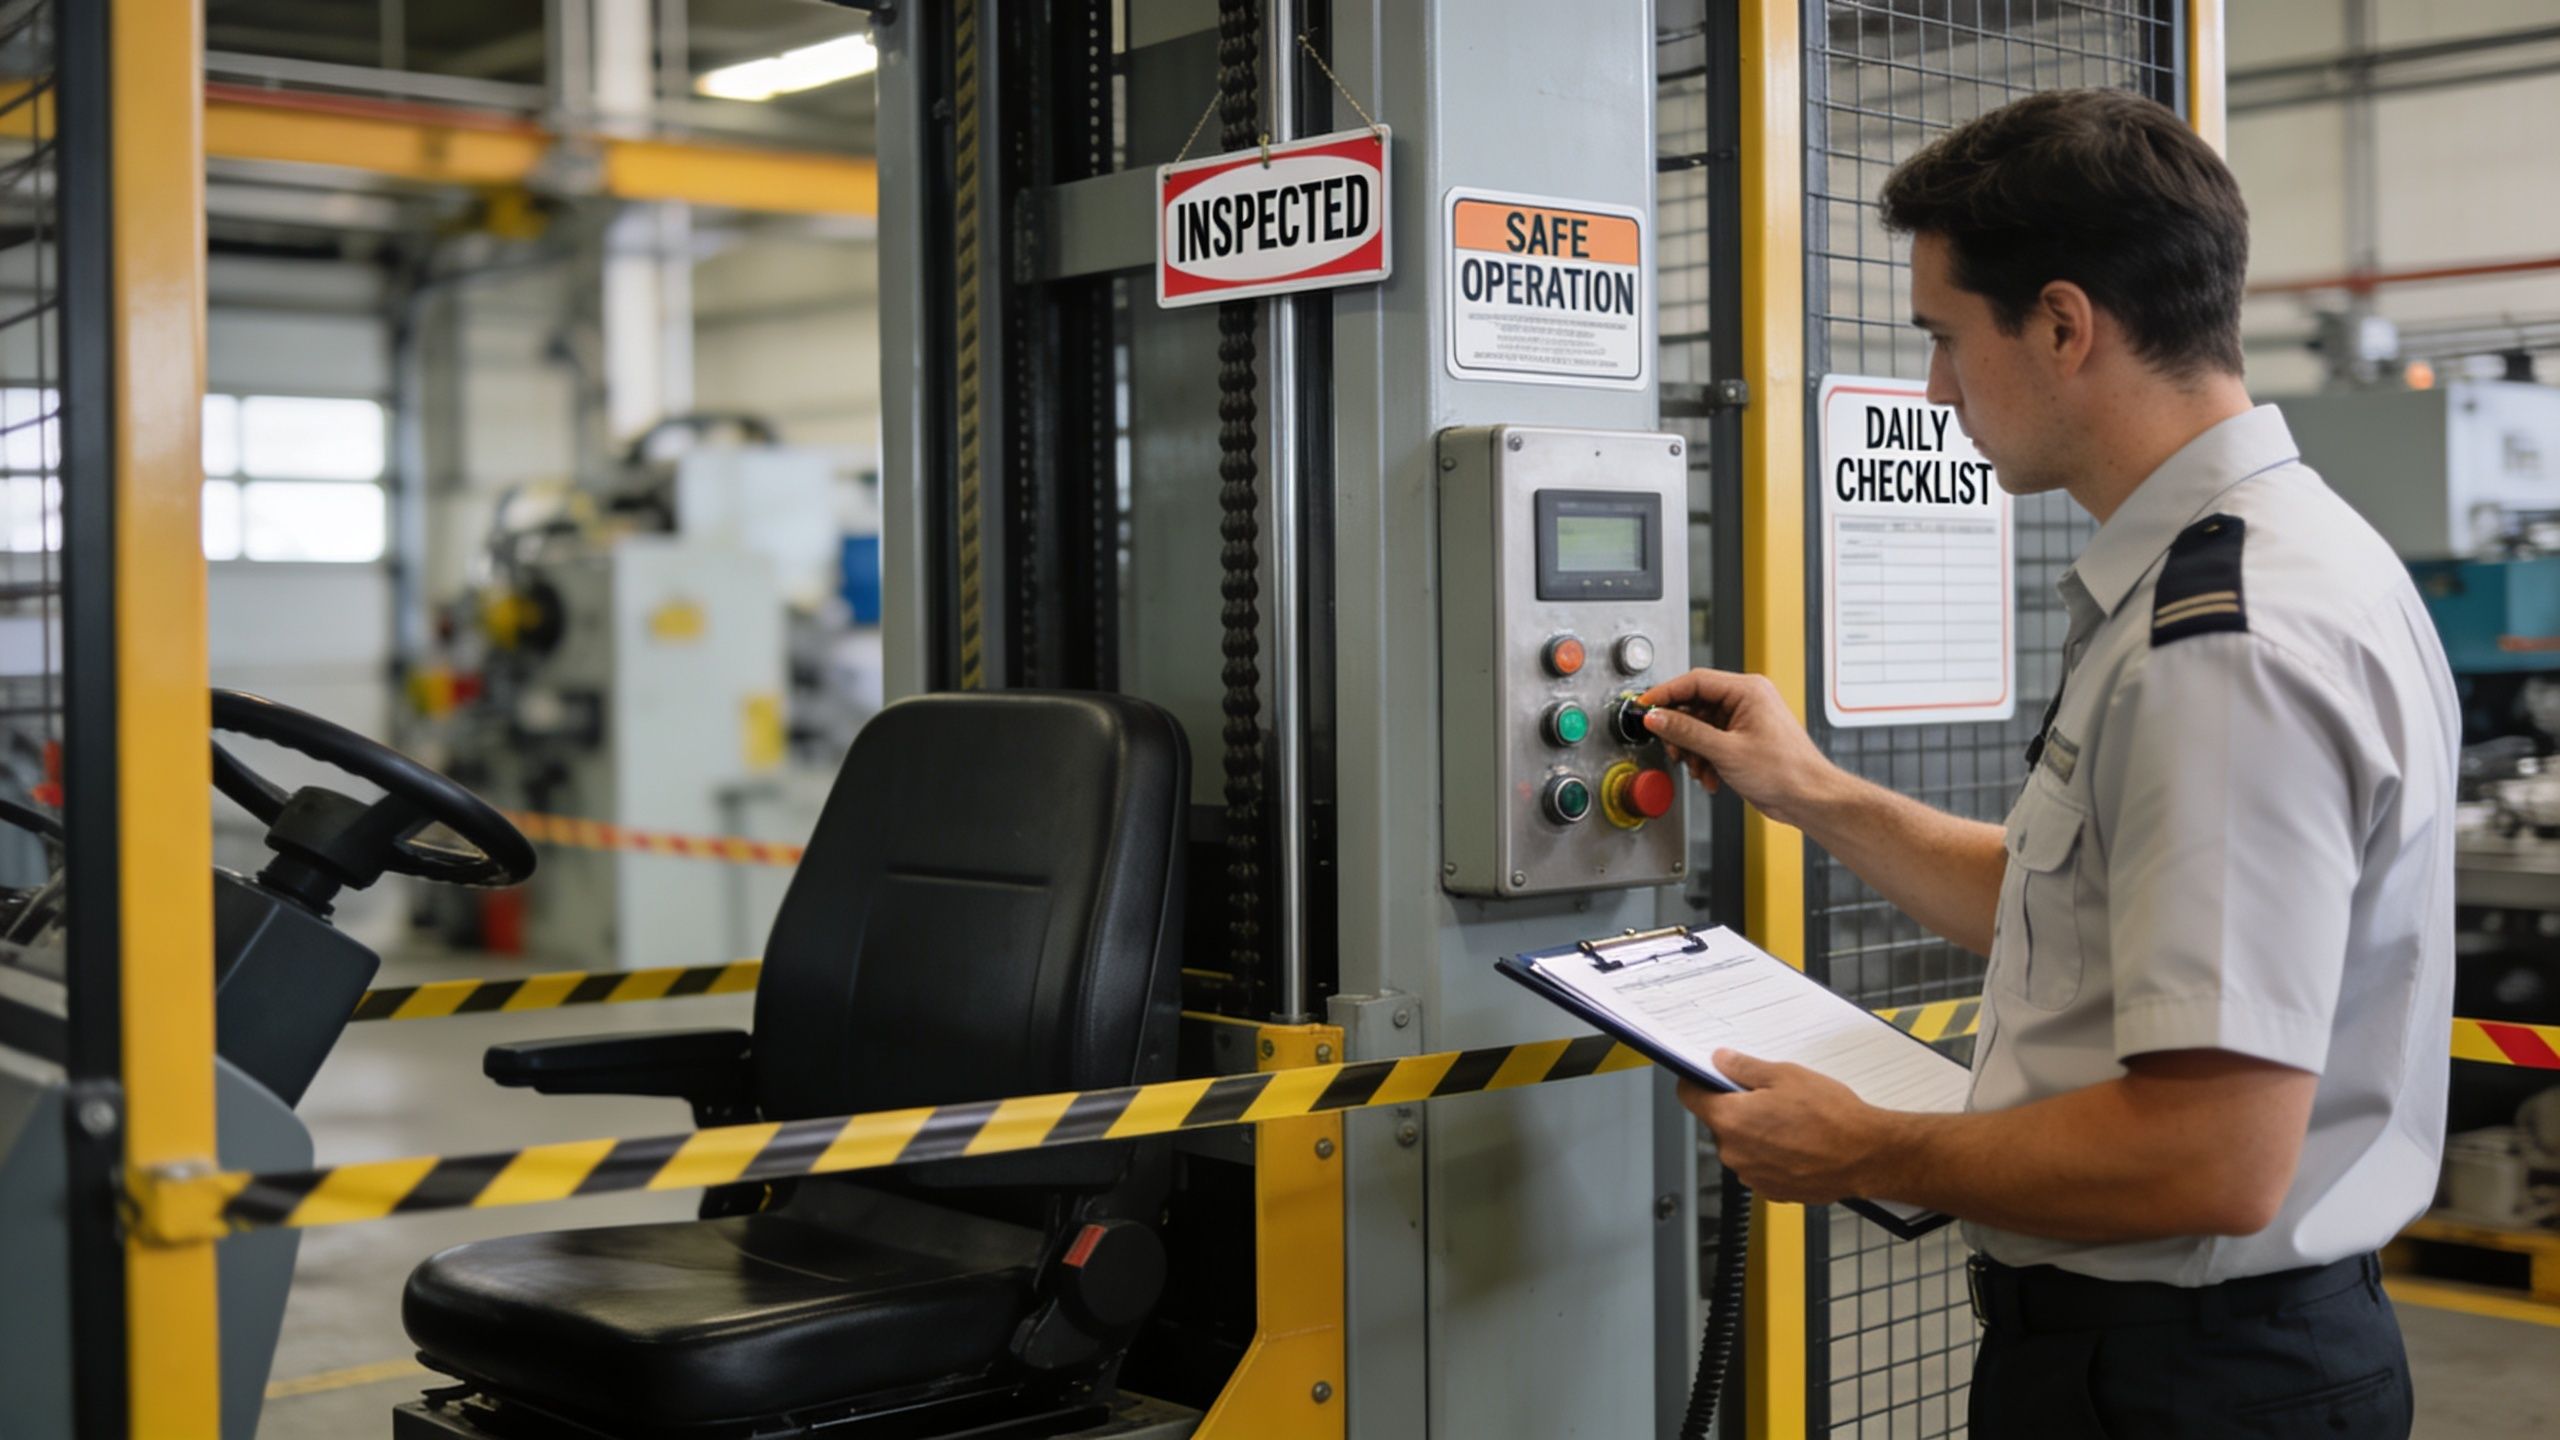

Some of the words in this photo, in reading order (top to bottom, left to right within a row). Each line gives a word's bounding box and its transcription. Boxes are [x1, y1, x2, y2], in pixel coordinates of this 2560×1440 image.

[1177, 174, 1369, 263] INSPECTED
[1506, 211, 1590, 258] SAFE
[1462, 258, 1634, 315] OPERATION
[1866, 406, 1949, 452] DAILY
[1836, 457, 1994, 505] CHECKLIST
